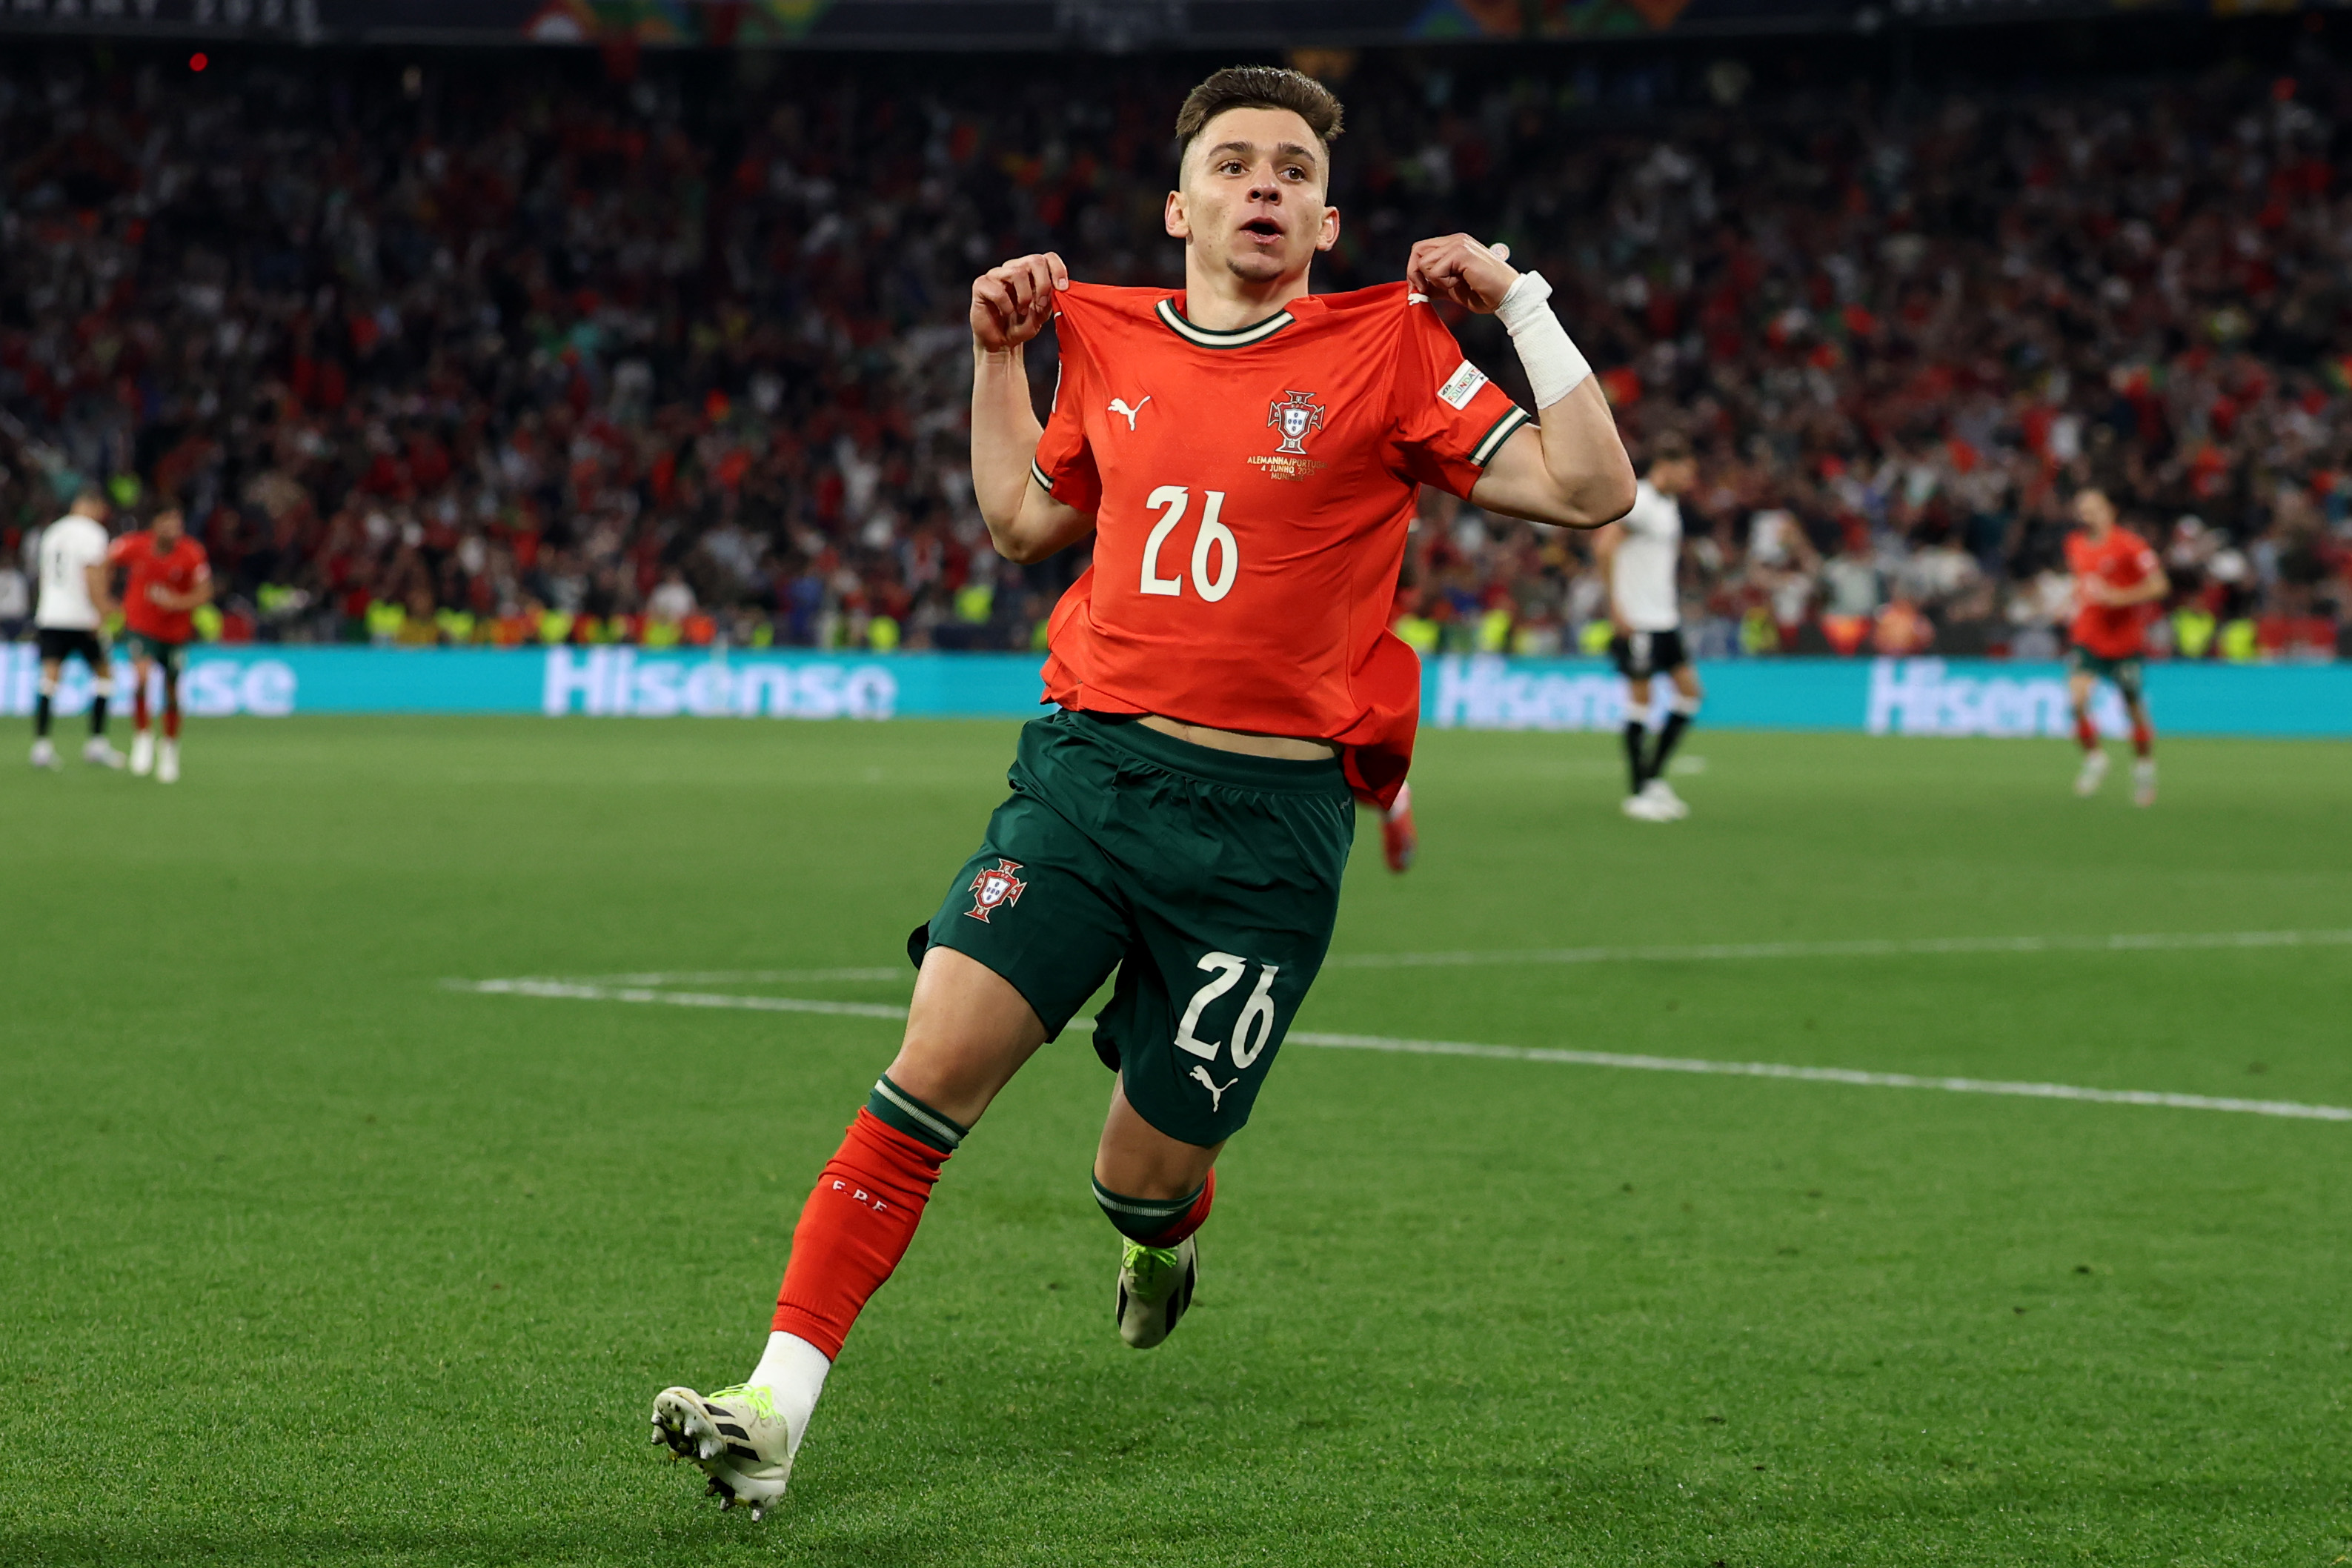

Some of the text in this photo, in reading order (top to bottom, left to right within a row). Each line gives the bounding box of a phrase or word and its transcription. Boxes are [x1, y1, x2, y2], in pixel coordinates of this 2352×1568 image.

[1441, 384, 1452, 396] UEFA
[1269, 465, 1295, 474] JUNHO
[1298, 468, 1315, 476] 2025
[1270, 473, 1304, 482] MUNIQUE
[1140, 485, 1239, 602] 26
[542, 645, 898, 719] Hisense
[1174, 951, 1279, 1069] 26
